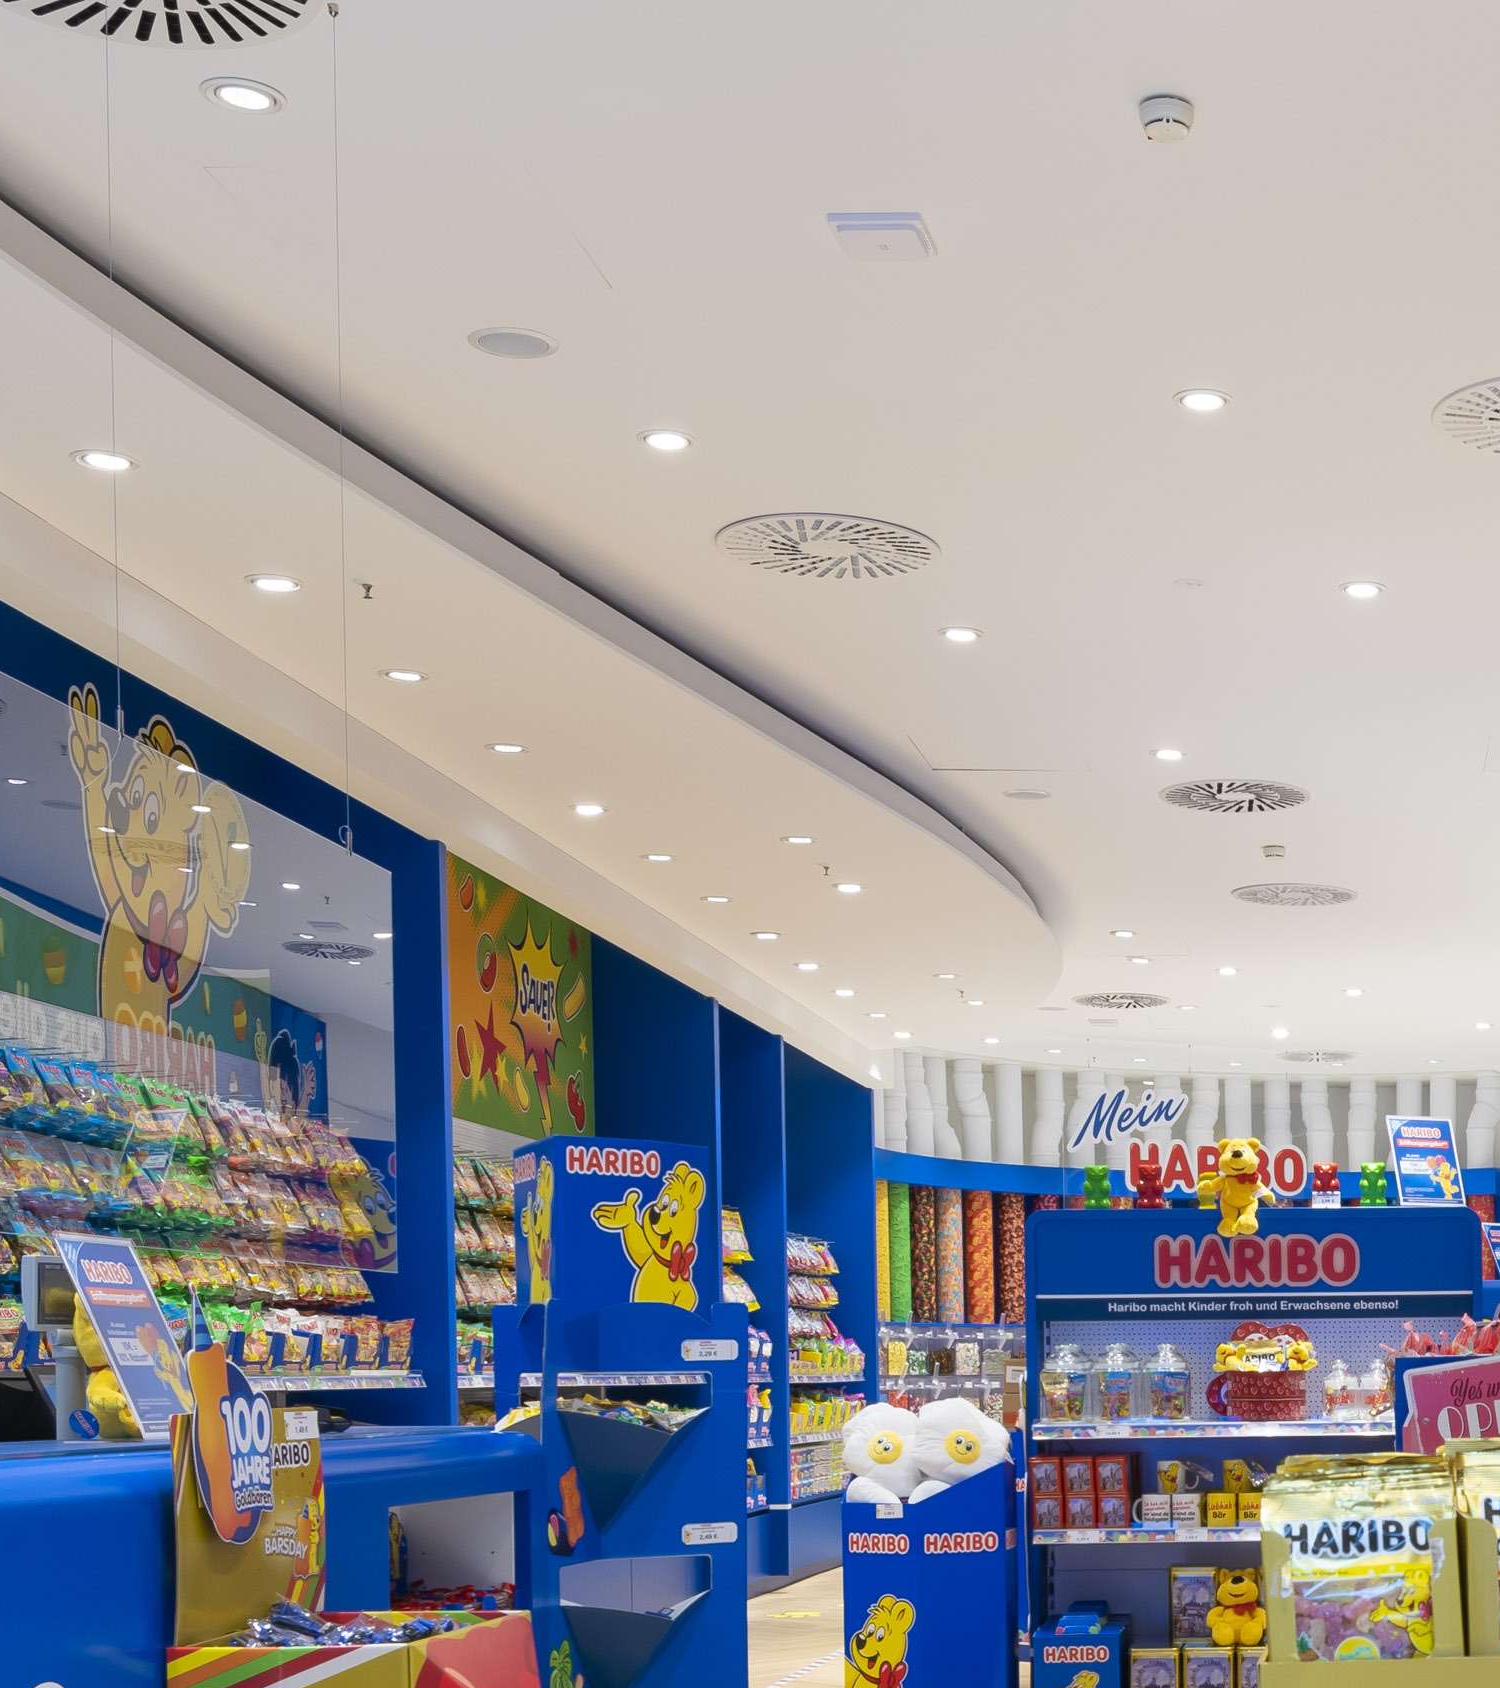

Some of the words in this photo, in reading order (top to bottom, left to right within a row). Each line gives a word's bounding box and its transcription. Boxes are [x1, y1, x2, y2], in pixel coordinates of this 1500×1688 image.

[1072, 1089, 1187, 1148] Mein
[567, 1148, 659, 1175] HARIBO
[81, 1260, 132, 1283] HARIBO
[1158, 1237, 1356, 1283] HARIBO
[1108, 1302, 1147, 1312] Haribo
[1150, 1301, 1186, 1312] macht
[1189, 1301, 1227, 1311] Kinder
[1230, 1300, 1253, 1311] froh
[1256, 1300, 1277, 1310] und
[1280, 1300, 1351, 1310] Erwachsene
[1354, 1299, 1398, 1309] ebenso!
[1451, 1378, 1482, 1408] Yes
[221, 1397, 270, 1454] 100
[232, 1455, 270, 1488] JAHRE
[235, 1488, 273, 1507] Goldbären
[1213, 1511, 1226, 1519] Bär
[849, 1532, 908, 1554] HARIBO
[924, 1531, 998, 1552] HARIBO
[1043, 1646, 1109, 1663] HARIBO
